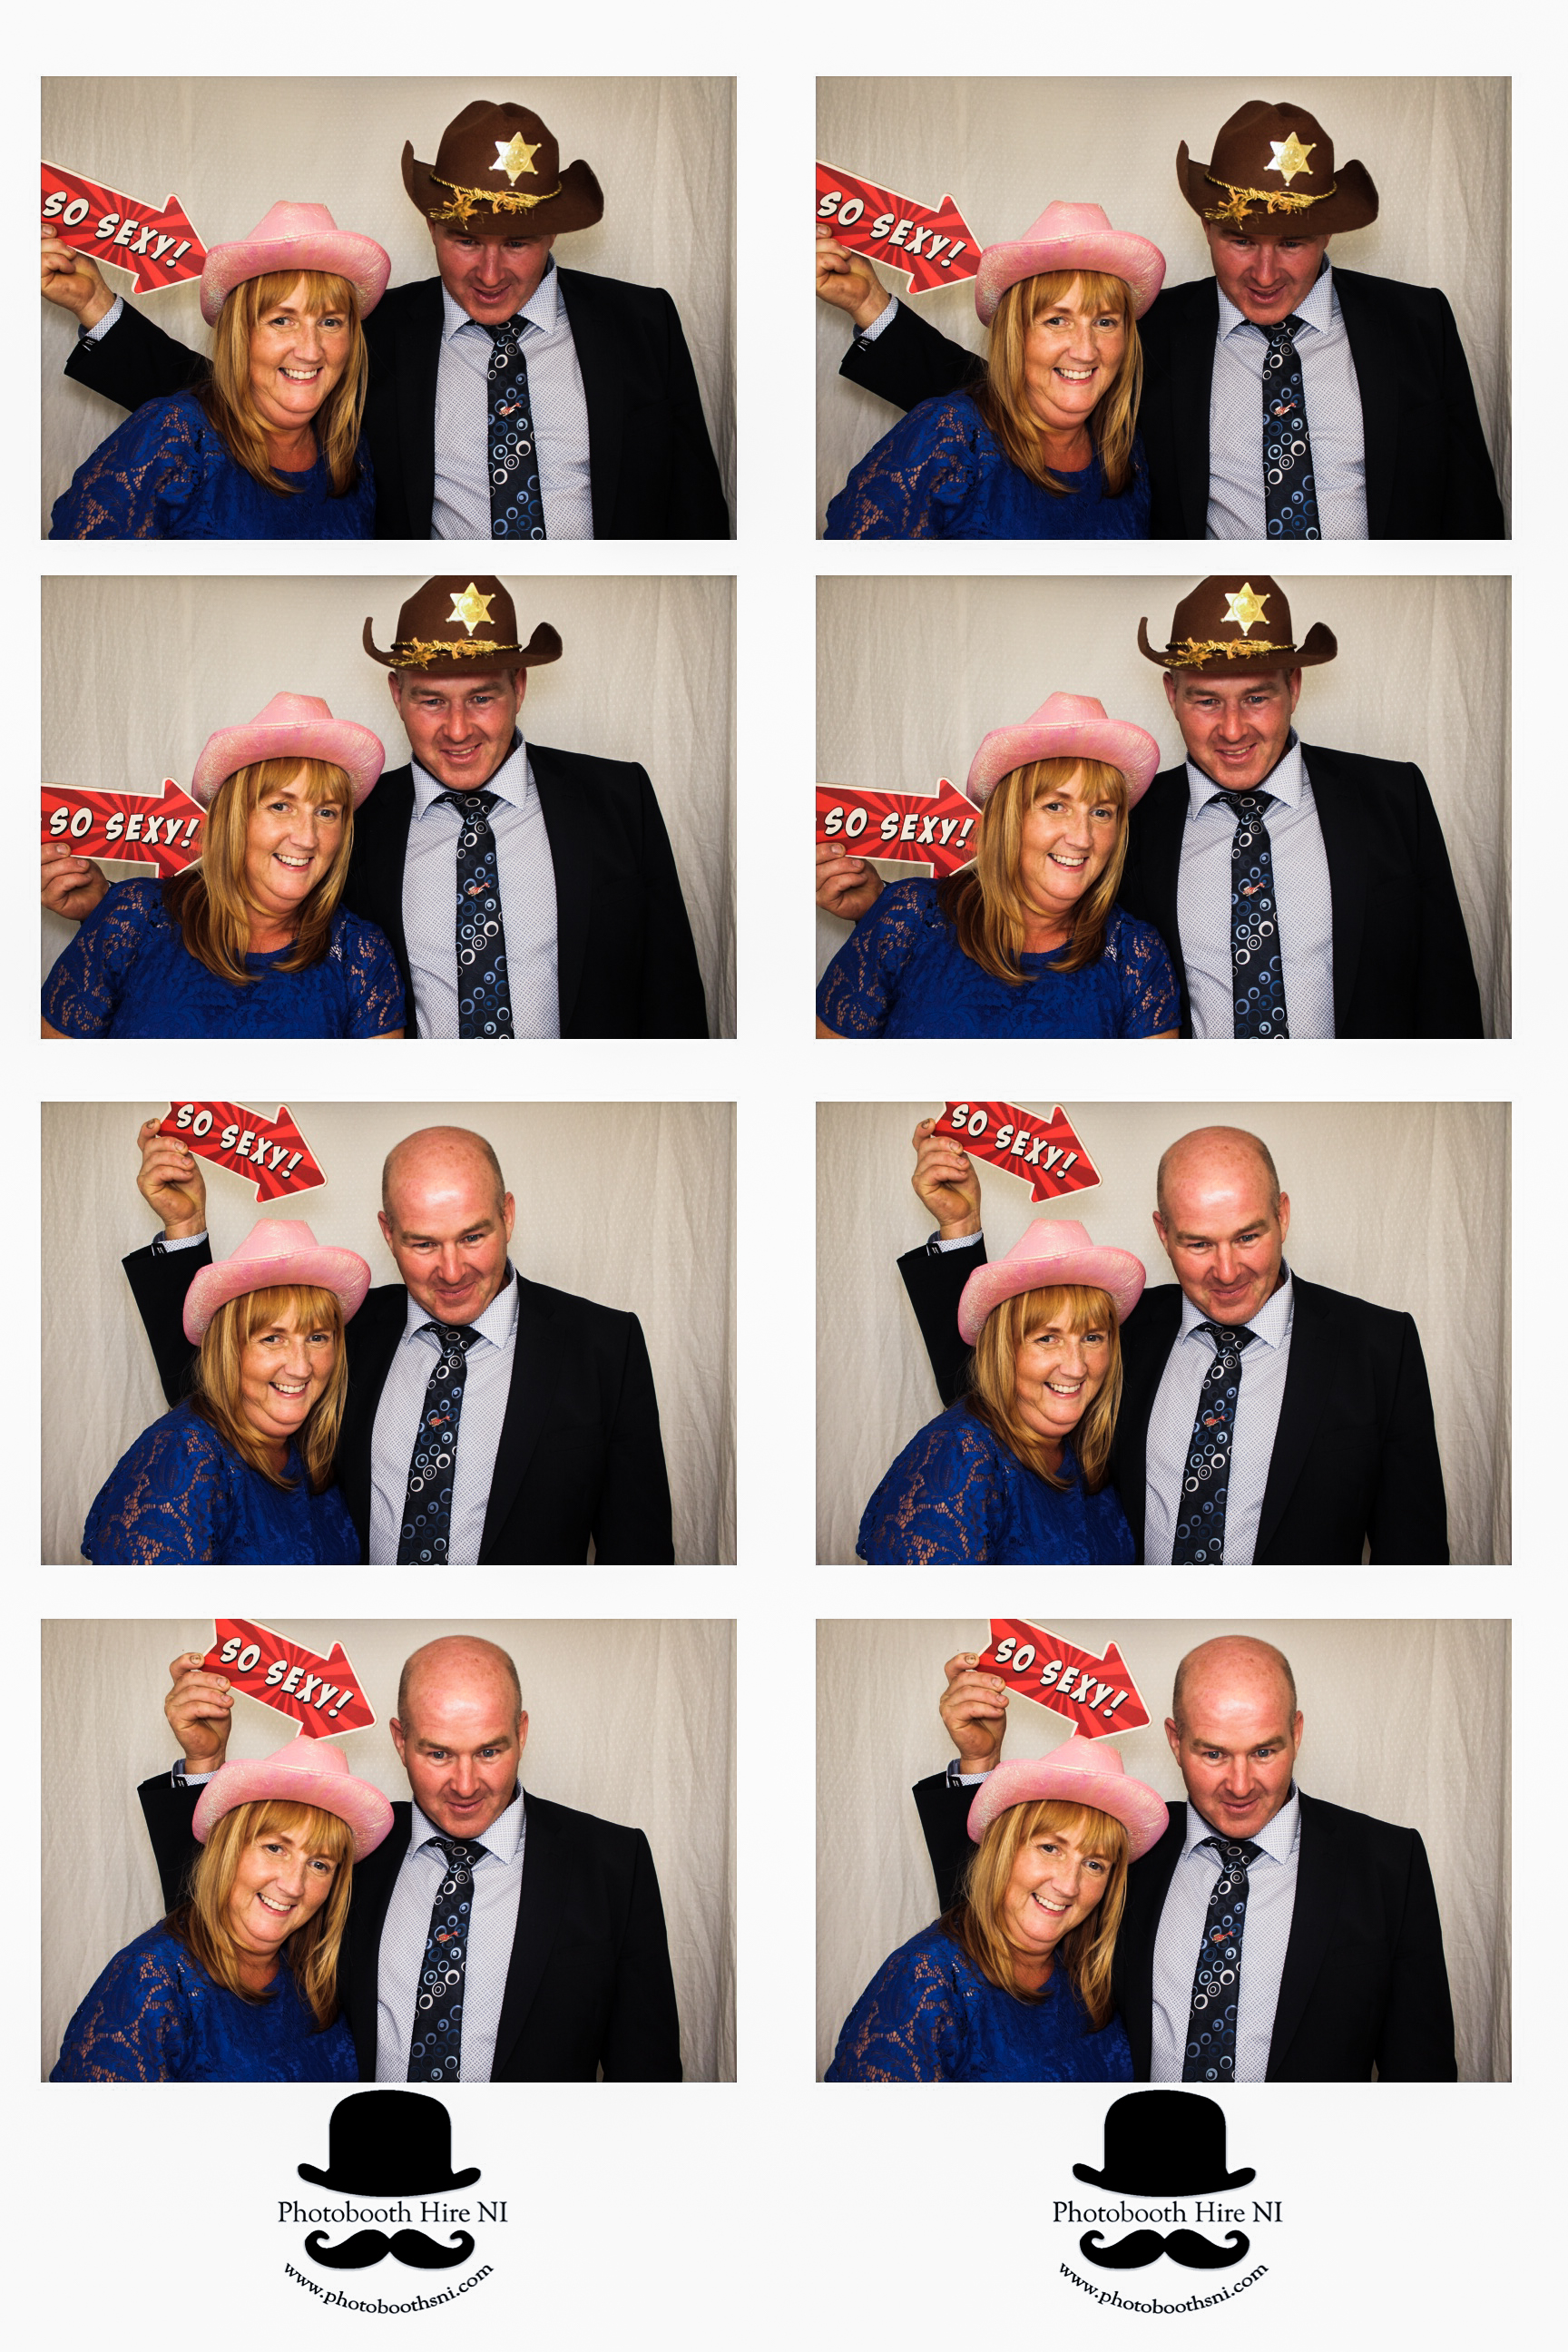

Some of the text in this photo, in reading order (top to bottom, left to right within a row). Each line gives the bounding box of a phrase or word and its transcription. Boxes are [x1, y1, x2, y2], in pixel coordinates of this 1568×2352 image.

[42, 191, 192, 269] SO SEXY!
[817, 191, 967, 269] SO SEXY!
[49, 807, 200, 848] SO SEXY!
[824, 807, 975, 848] SO SEXY!
[176, 1103, 304, 1179] SO SEXY!
[951, 1103, 1079, 1179] SO SEXY!
[220, 1637, 354, 1719] SO SEXY!
[995, 1637, 1129, 1719] SO SEXY!
